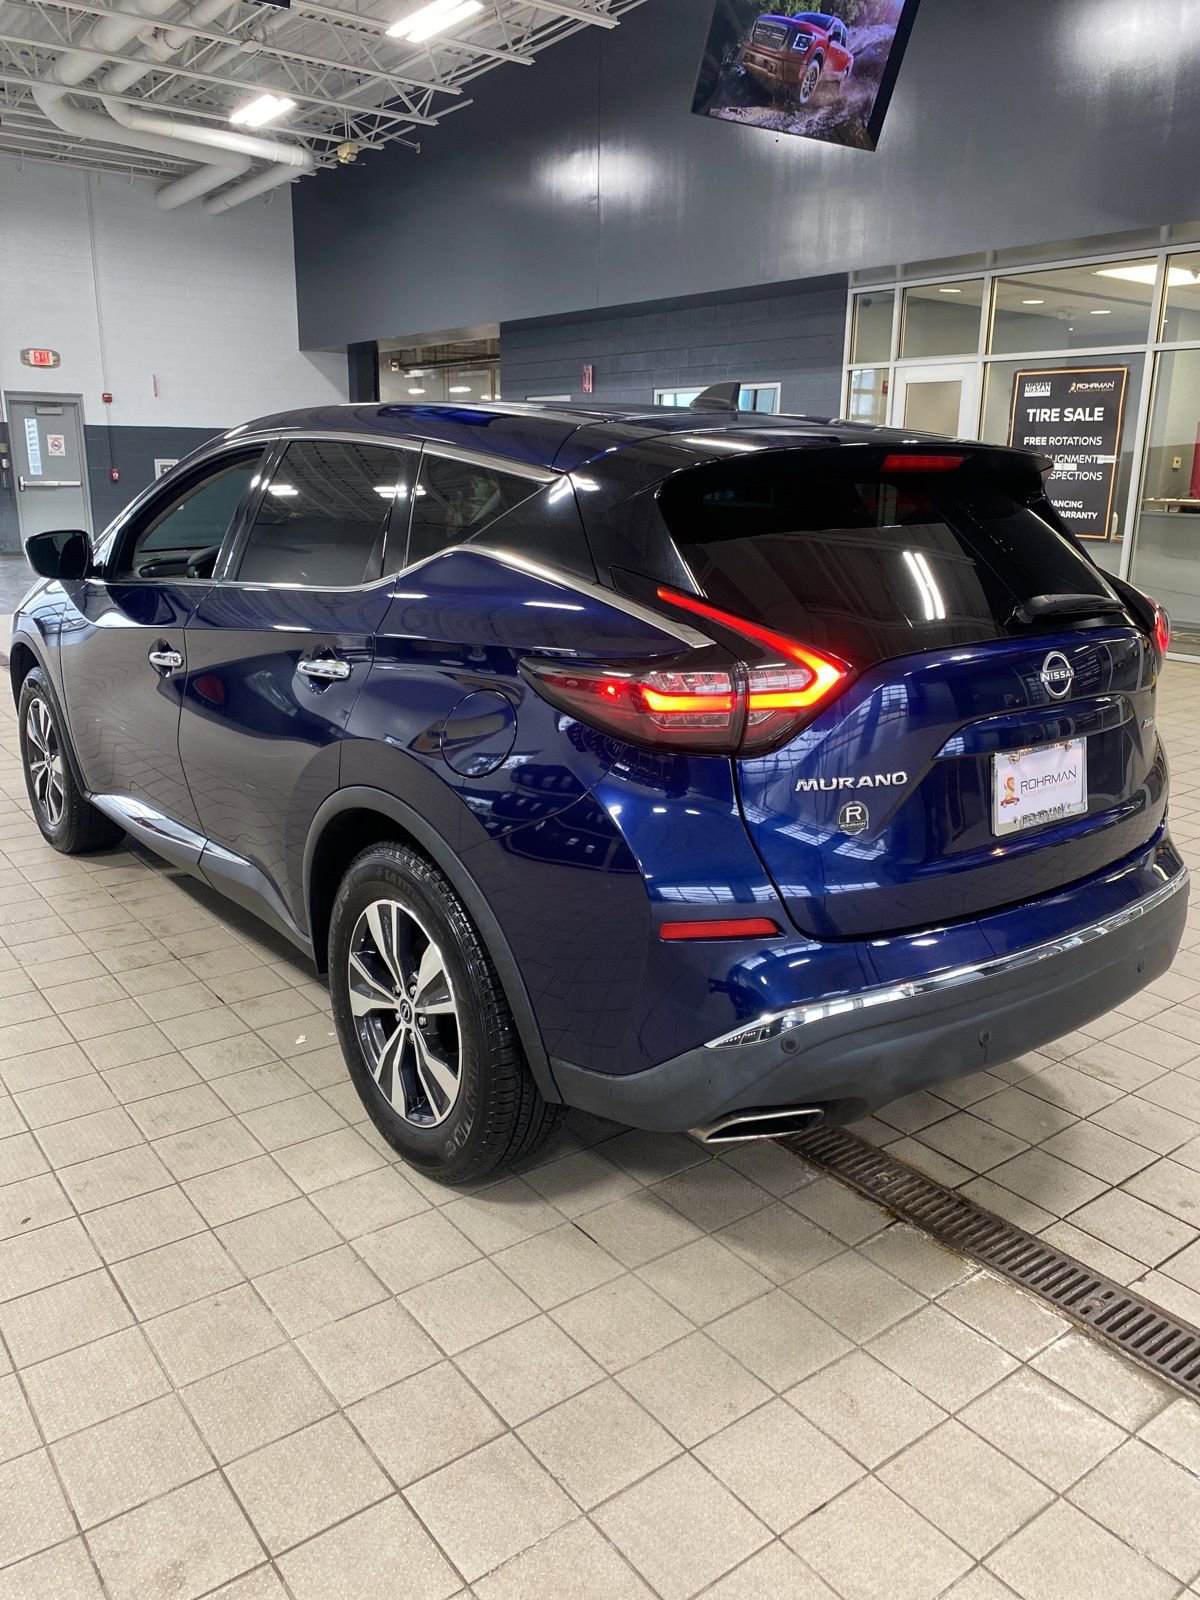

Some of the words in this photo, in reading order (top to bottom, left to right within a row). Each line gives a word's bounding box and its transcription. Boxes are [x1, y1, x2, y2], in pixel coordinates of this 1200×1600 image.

[33, 351, 50, 364] EXIT
[1025, 385, 1051, 393] NISSAN
[1076, 381, 1115, 390] ROHRMAN
[1026, 408, 1061, 422] TIRE
[1063, 407, 1105, 422] SALE
[1023, 436, 1047, 446] FREE
[1048, 436, 1103, 446] ROTATIONS
[1048, 471, 1103, 481] SPECTIONS
[1041, 669, 1074, 682] NISSAN
[795, 771, 908, 792] MURANO
[1020, 765, 1077, 794] ROHRMAN
[845, 805, 862, 824] R
